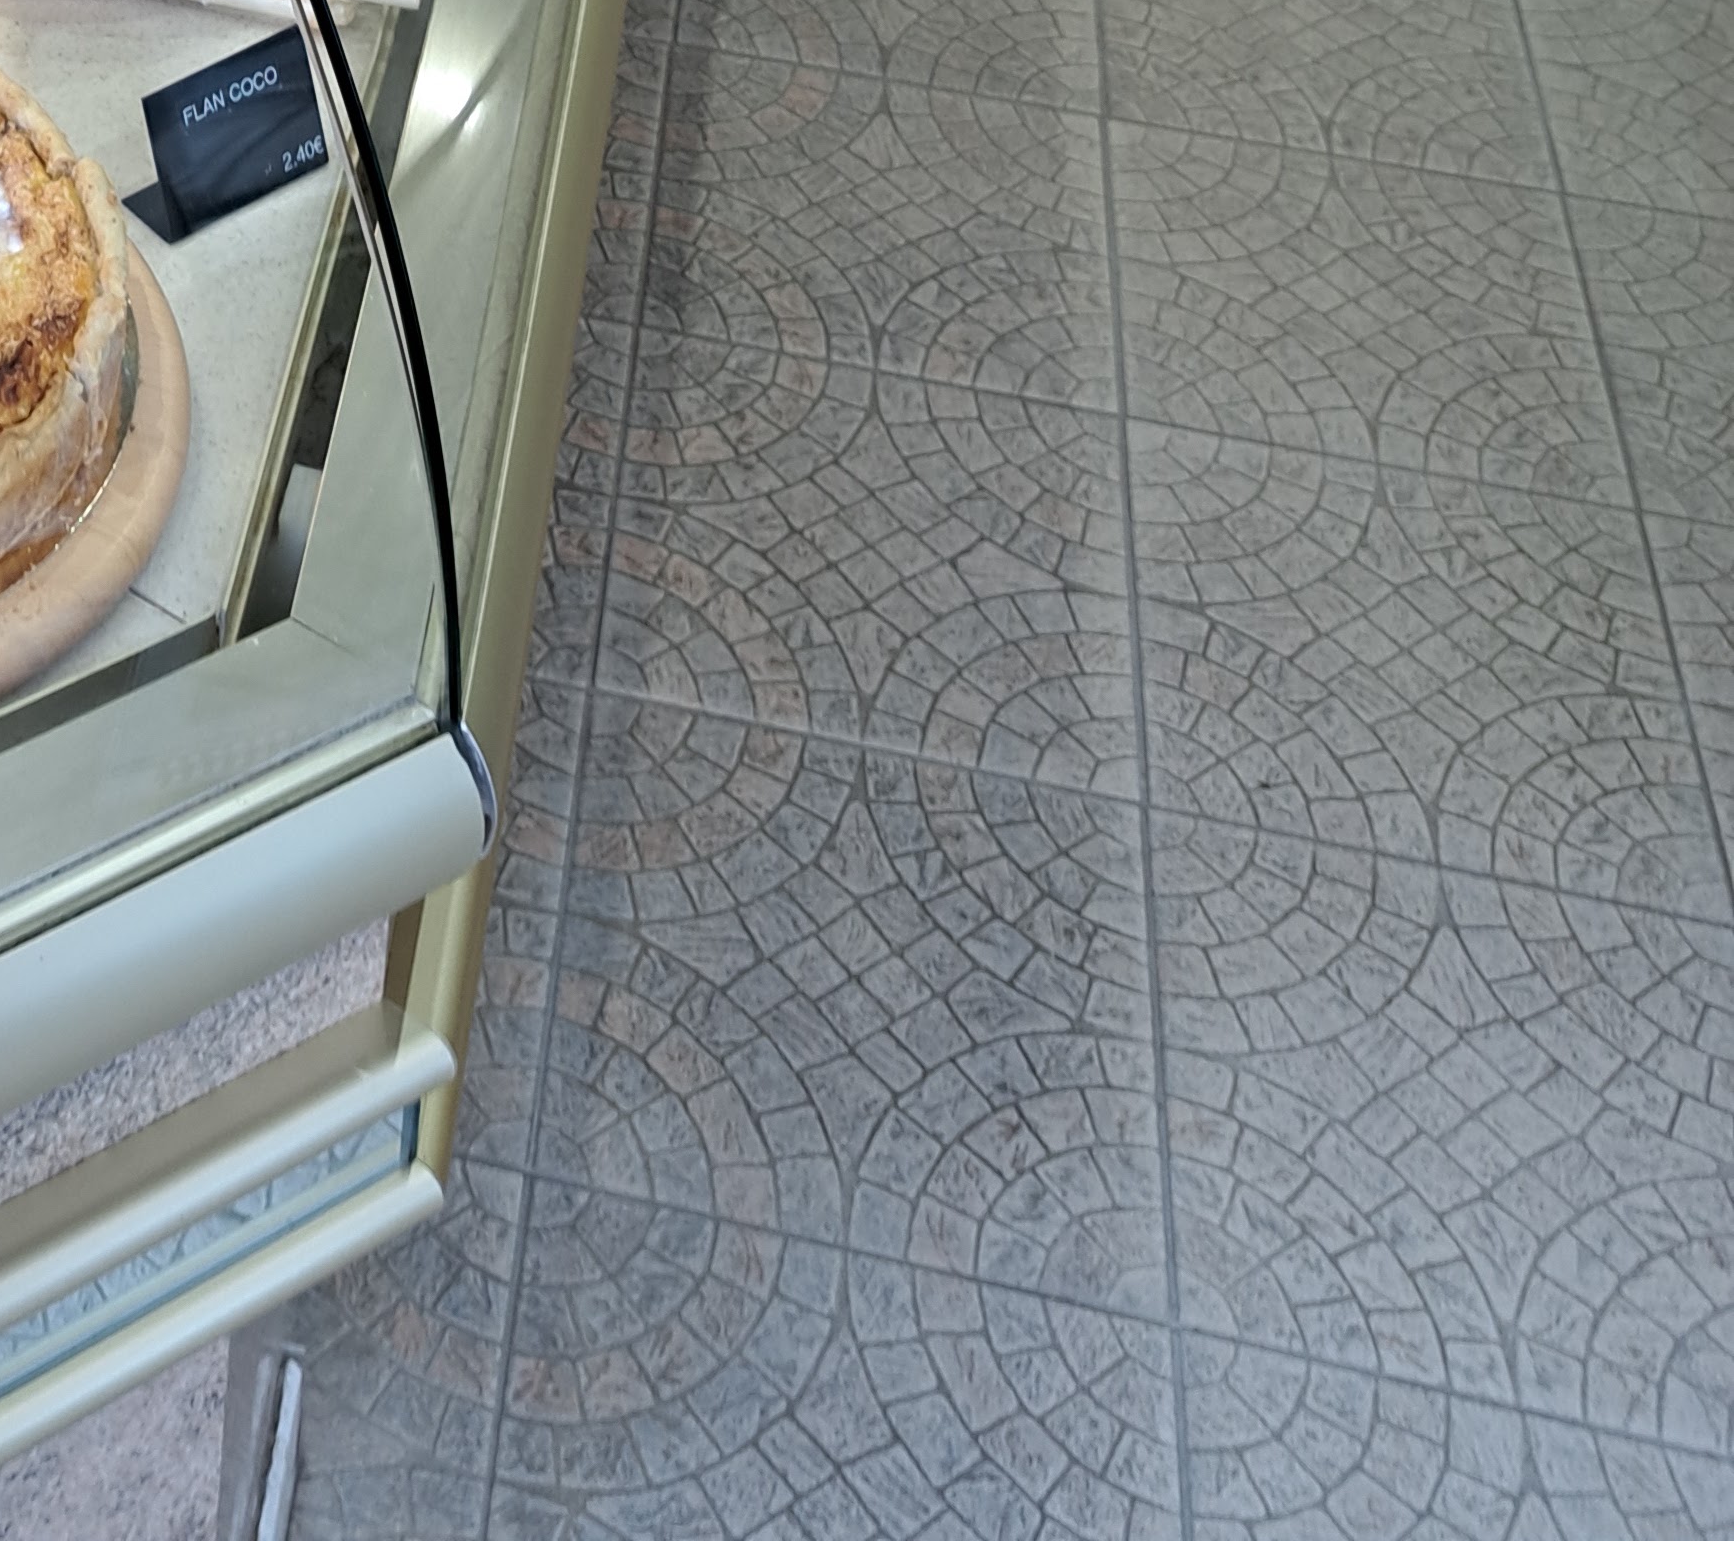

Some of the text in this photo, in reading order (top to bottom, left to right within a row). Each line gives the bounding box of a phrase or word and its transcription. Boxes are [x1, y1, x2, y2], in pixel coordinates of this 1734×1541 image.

[182, 66, 278, 127] FLAN COCO
[281, 134, 326, 173] 2.40€
